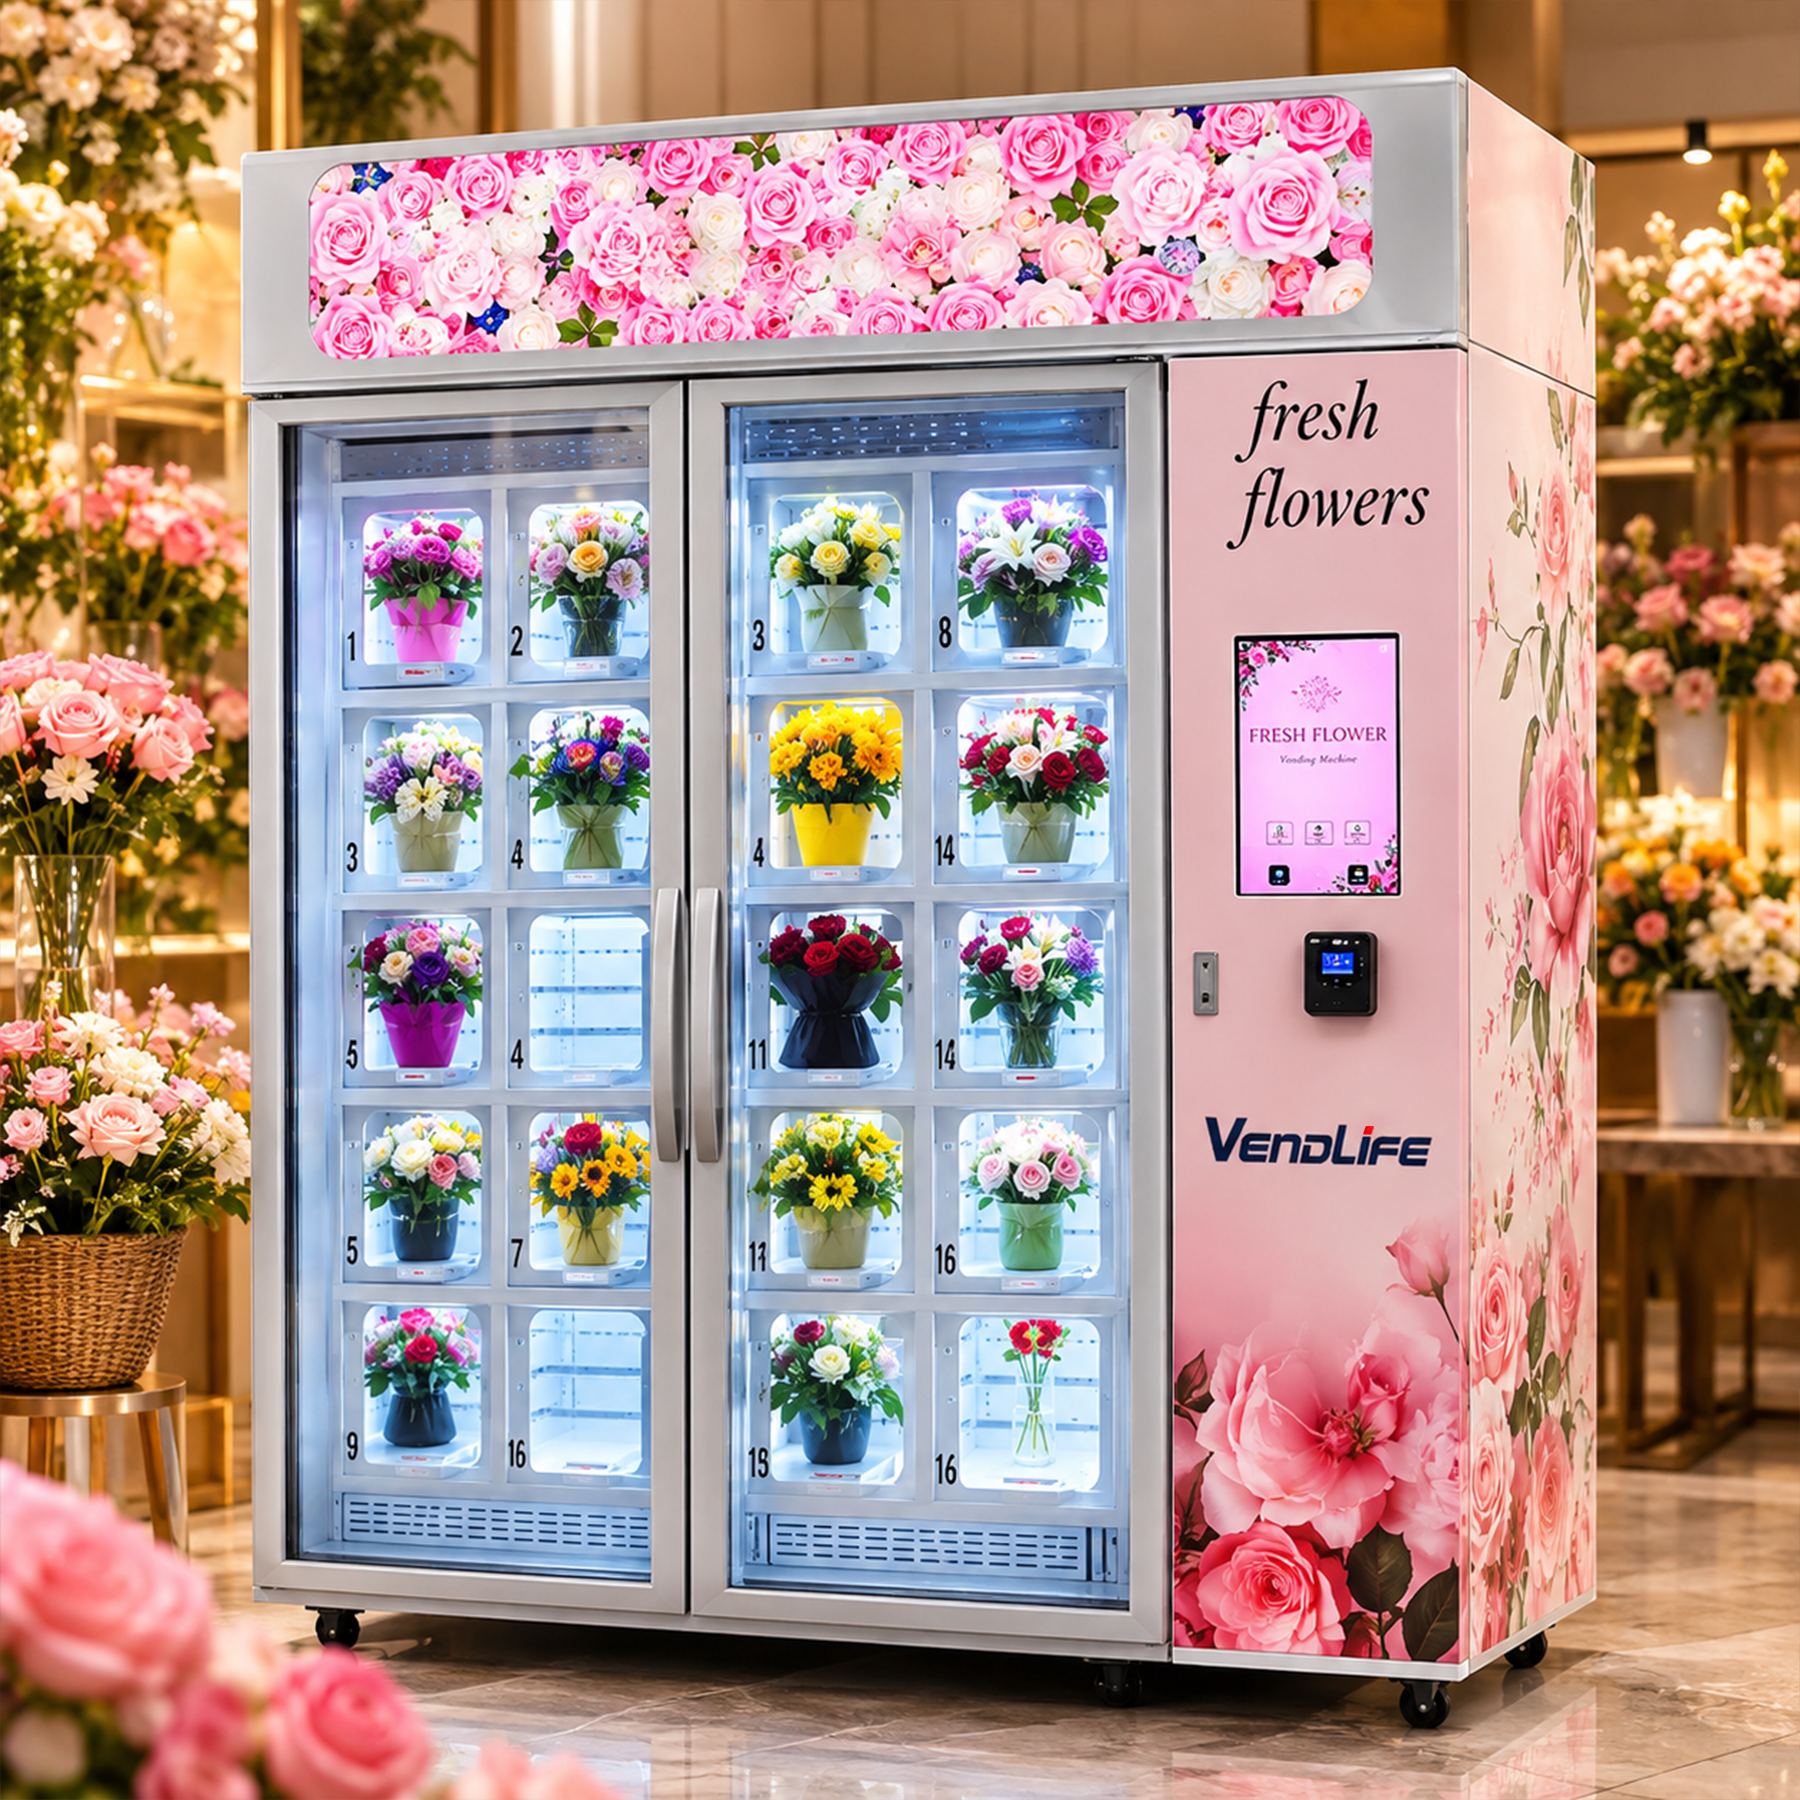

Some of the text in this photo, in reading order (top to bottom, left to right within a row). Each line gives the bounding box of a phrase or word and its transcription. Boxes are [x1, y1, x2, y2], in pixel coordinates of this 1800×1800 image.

[1234, 378, 1379, 463] fresh
[1226, 467, 1430, 550] flowers
[347, 631, 355, 661] 1
[510, 625, 523, 657] 2
[752, 619, 765, 651] 3
[938, 615, 952, 649] 8
[1249, 726, 1388, 744] FRESH FLOWER
[346, 842, 358, 873] 3
[511, 839, 523, 870] 4
[935, 834, 955, 867] 14
[346, 1039, 358, 1070] 5
[511, 1038, 524, 1070] 4
[748, 1038, 766, 1070] 11
[935, 1038, 956, 1070] 14
[346, 1235, 358, 1265] 5
[511, 1238, 524, 1268] 7
[935, 1243, 956, 1275] 16
[346, 1431, 359, 1461] 9
[508, 1439, 526, 1469] 16
[935, 1453, 957, 1485] 16
